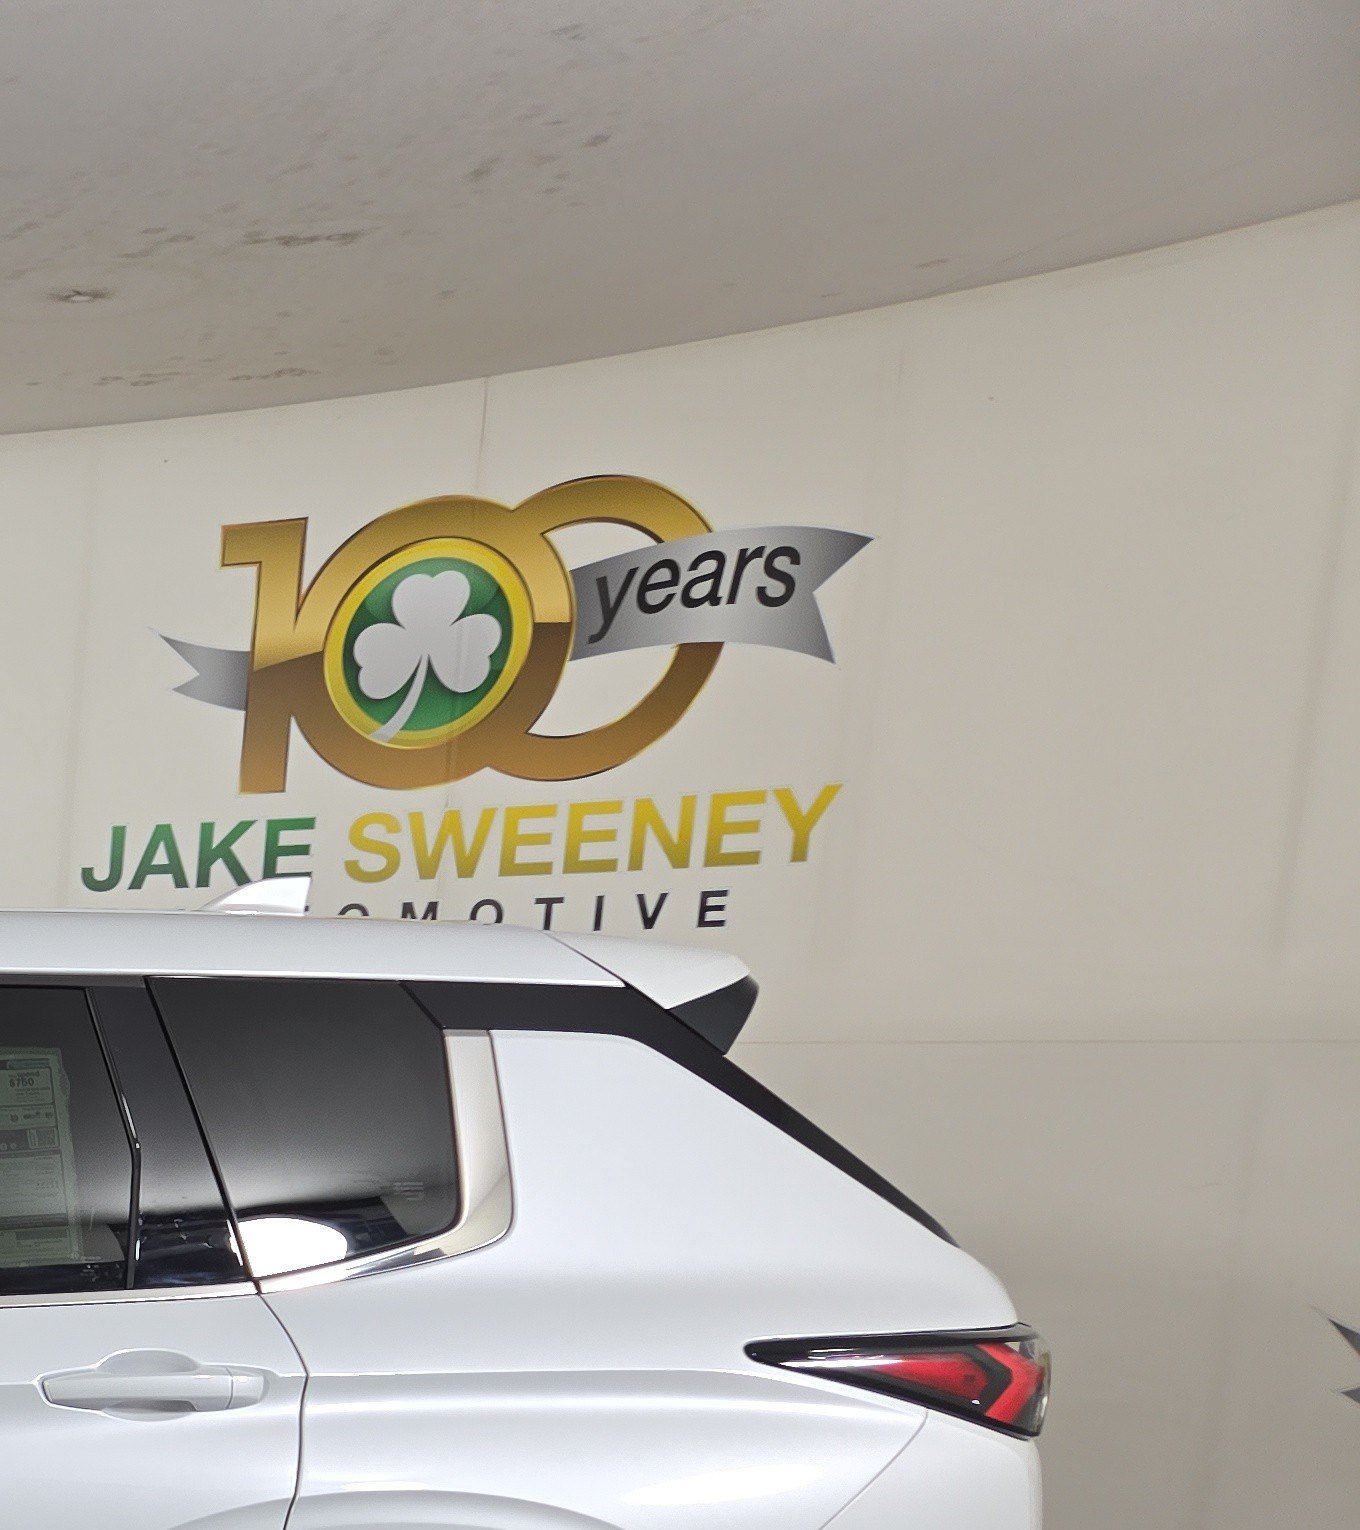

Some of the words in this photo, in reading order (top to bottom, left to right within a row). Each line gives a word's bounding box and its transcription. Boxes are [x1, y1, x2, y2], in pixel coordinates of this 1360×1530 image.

[219, 473, 726, 796] 100
[588, 545, 801, 645] years
[82, 816, 316, 892] JAKE
[343, 783, 844, 884] SWEENEY
